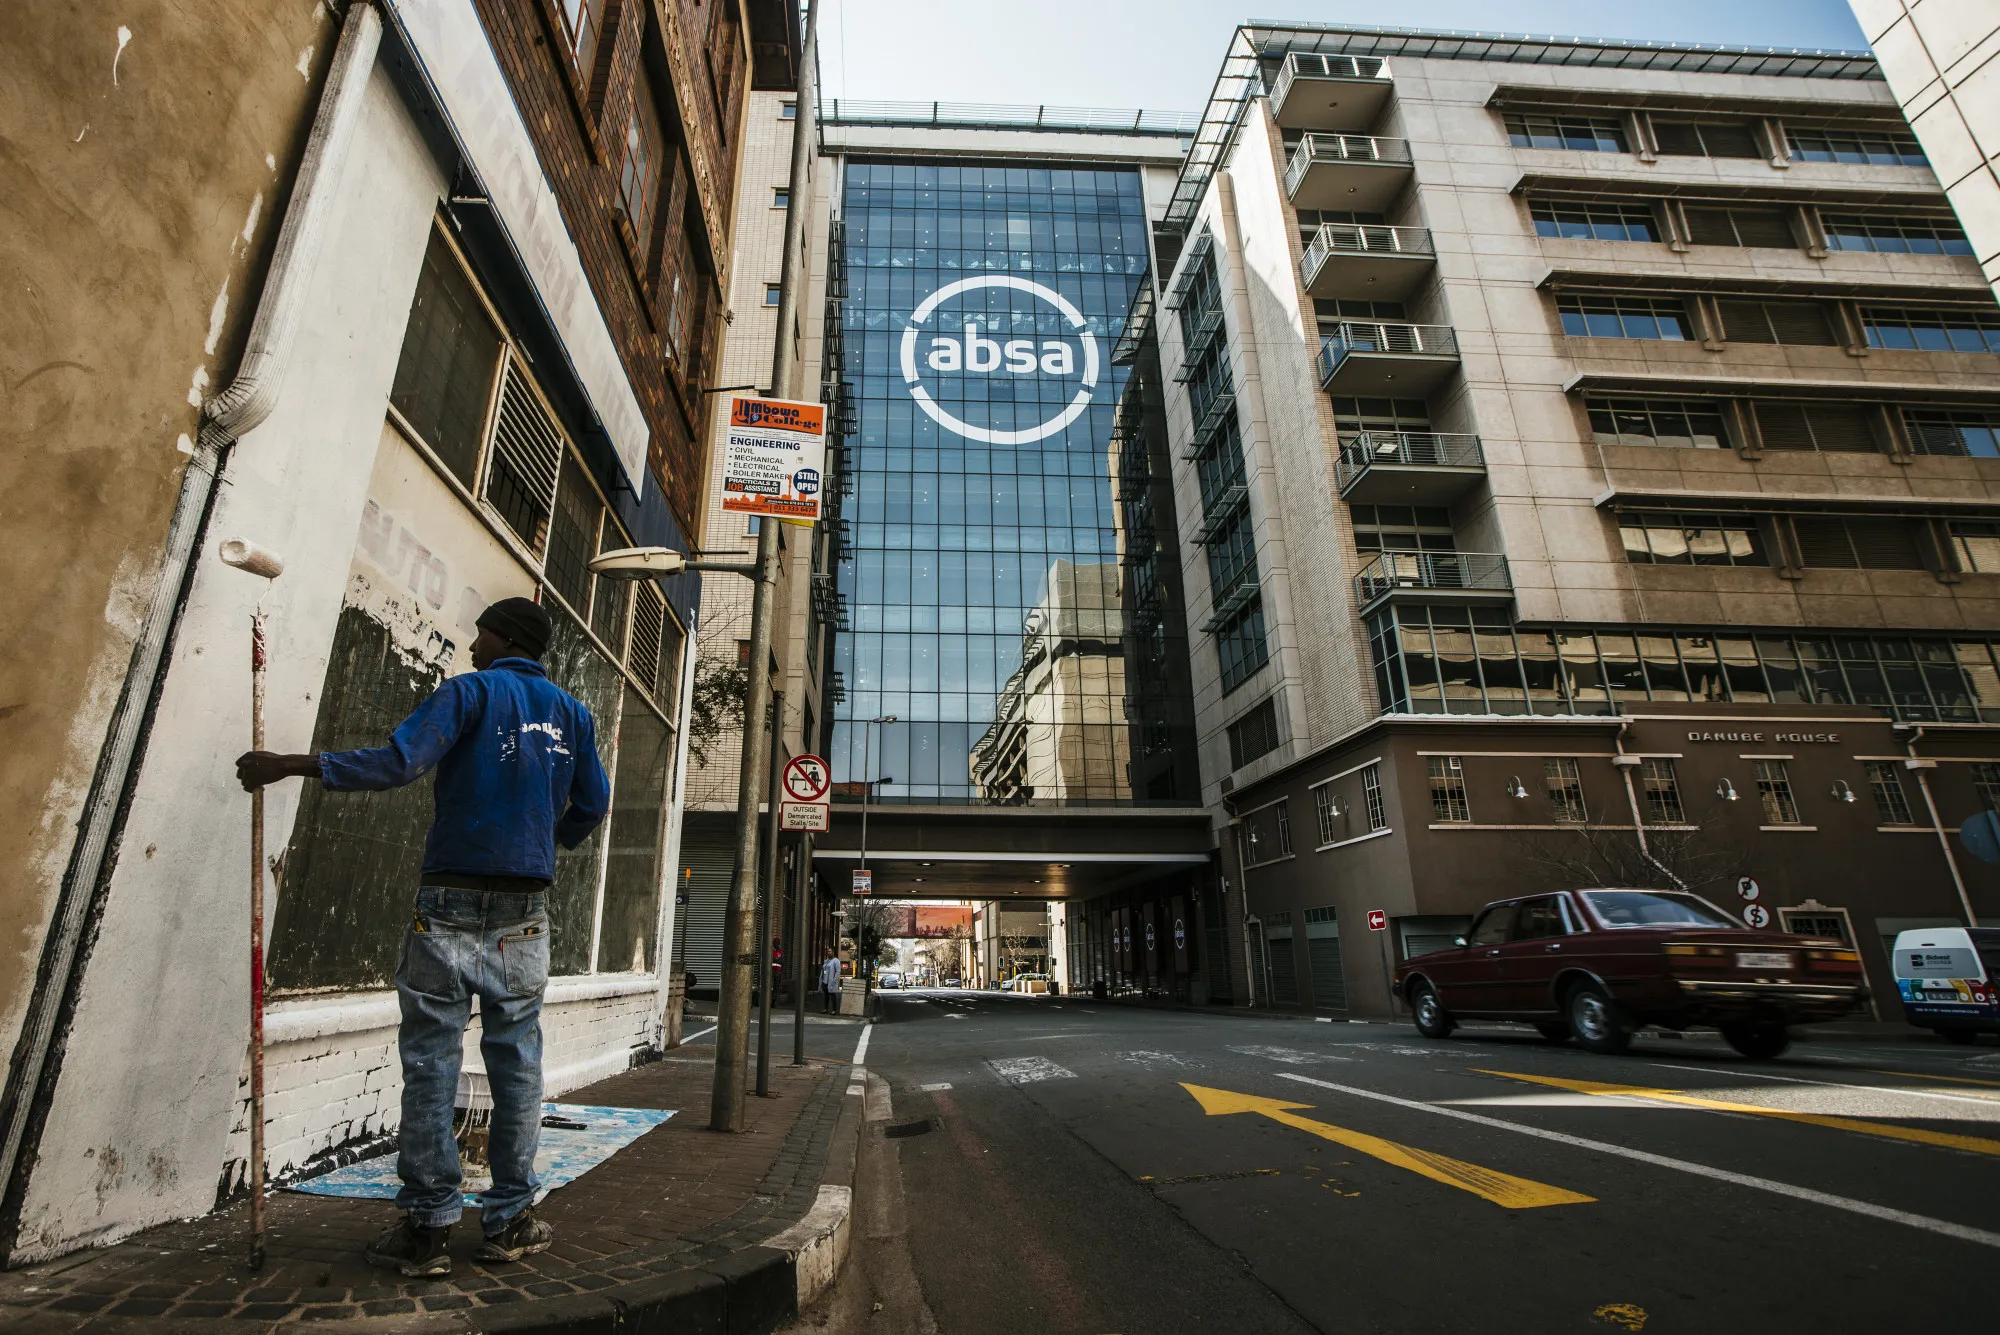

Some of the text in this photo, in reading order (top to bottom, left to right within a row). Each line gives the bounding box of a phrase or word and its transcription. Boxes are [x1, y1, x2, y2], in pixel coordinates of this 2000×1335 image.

[928, 323, 1074, 376] absa
[763, 415, 820, 429] College
[730, 437, 801, 451] ENGINEERING
[734, 455, 785, 464] MECHANICAL
[733, 462, 781, 471] ELECTRICAL
[733, 470, 790, 480] BOILER MAKER
[797, 472, 818, 481] STILL
[726, 483, 779, 493] JOB ASSISTANCE
[797, 483, 817, 492] OPEN
[1687, 732, 1840, 743] DANUBE HOUSE
